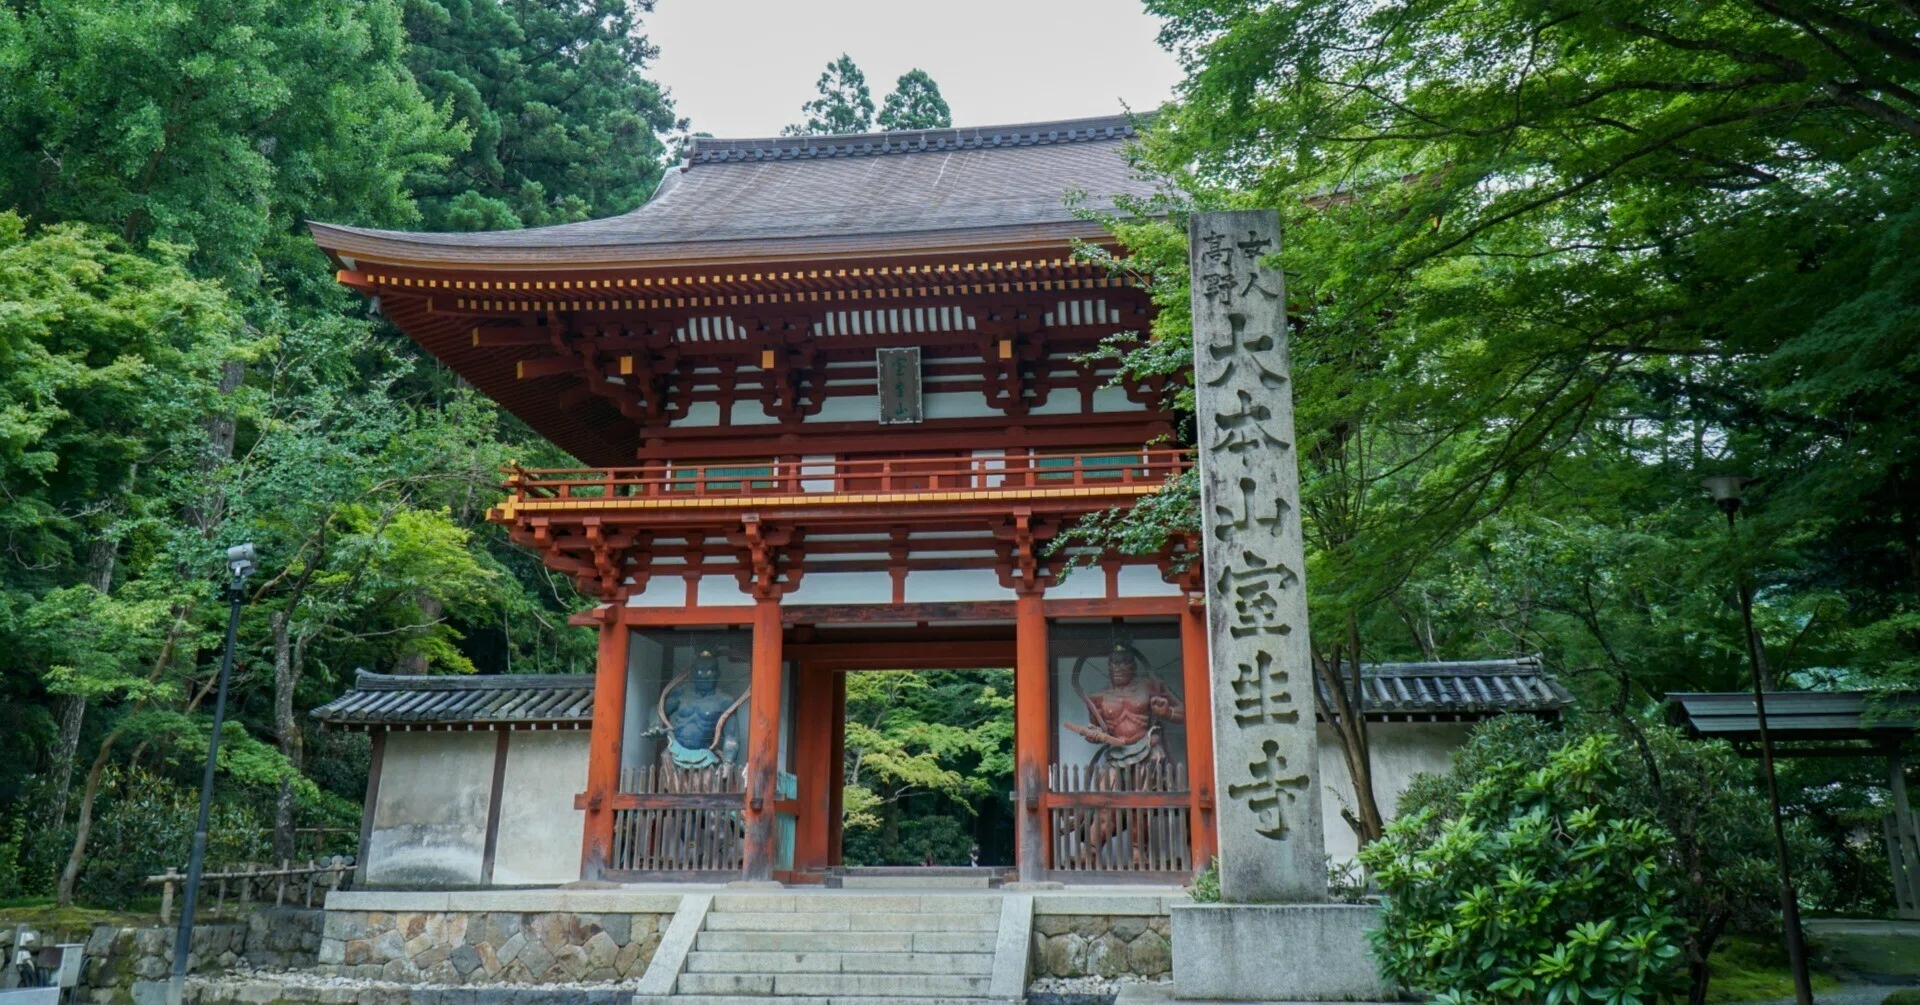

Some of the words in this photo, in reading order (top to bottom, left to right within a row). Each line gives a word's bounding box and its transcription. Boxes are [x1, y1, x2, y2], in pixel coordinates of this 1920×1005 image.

[1202, 230, 1238, 305] 高野
[1237, 230, 1278, 299] 女人
[1208, 313, 1310, 841] 大本山室生寺
